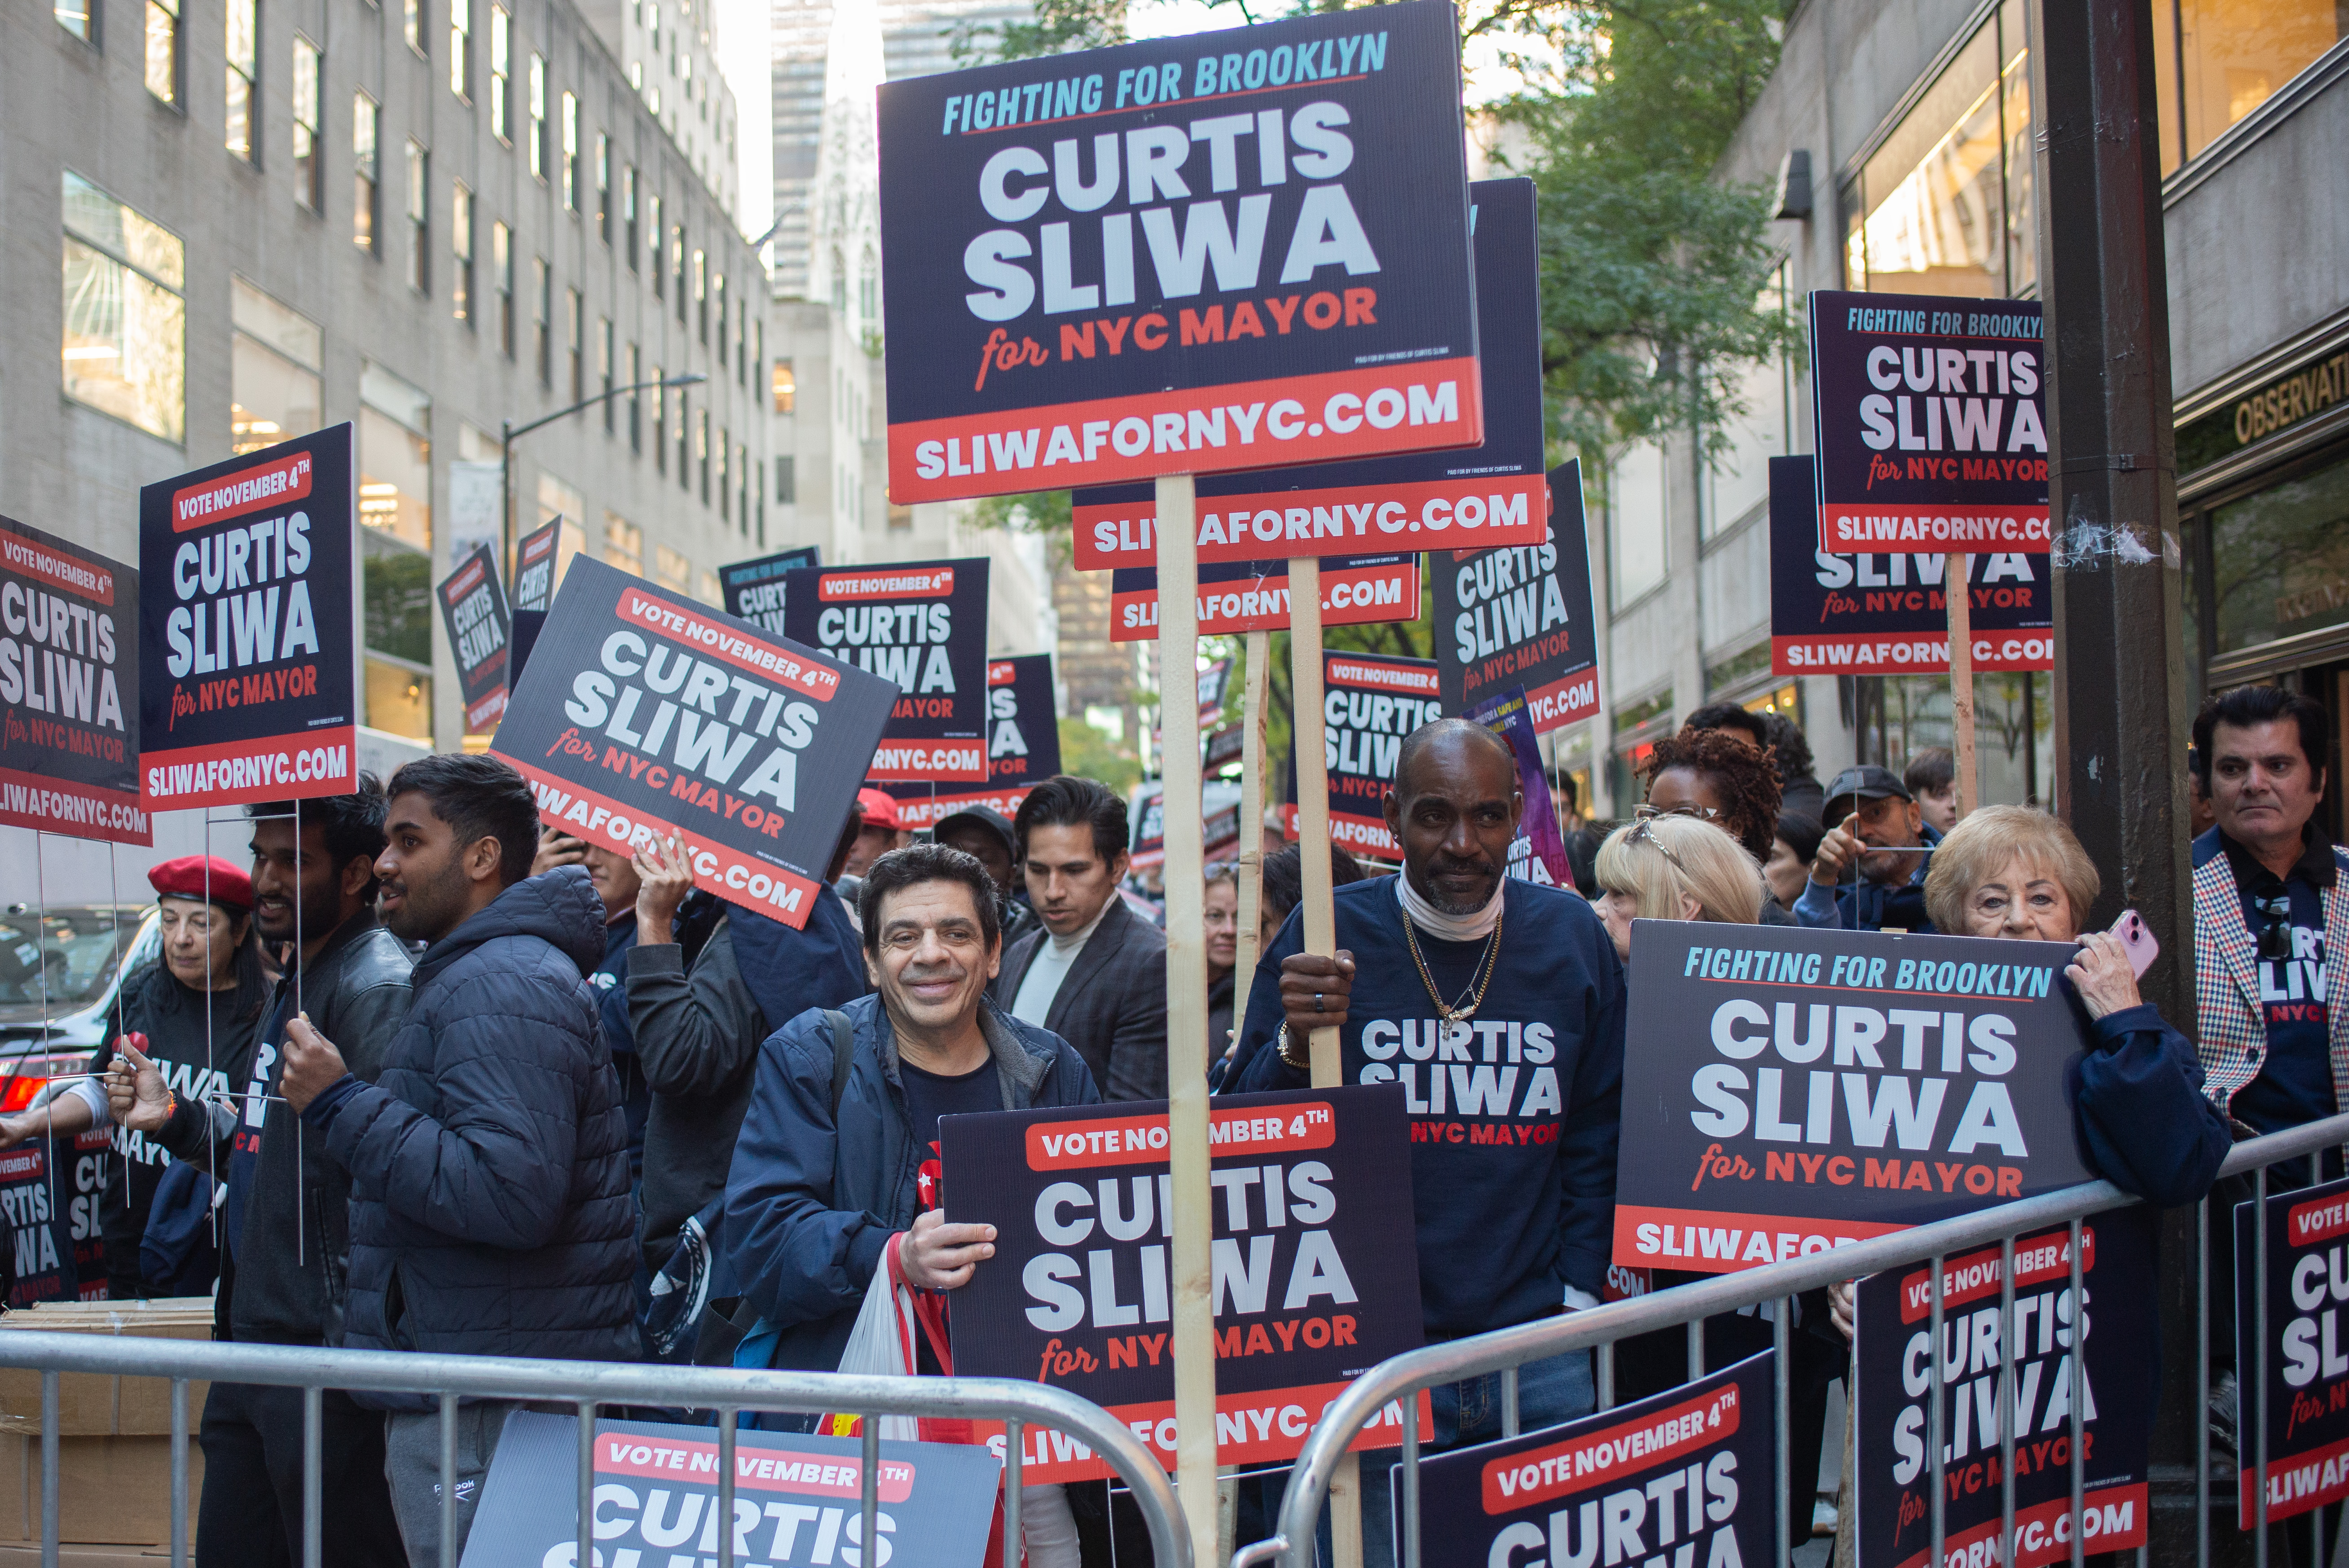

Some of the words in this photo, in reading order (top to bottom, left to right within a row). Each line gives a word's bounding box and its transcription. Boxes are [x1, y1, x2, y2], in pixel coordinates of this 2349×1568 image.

[943, 74, 1103, 136] FIGHTING
[1116, 61, 1181, 109] FOR
[1195, 31, 1388, 97] BROOKLYN
[980, 101, 1354, 222] CURTIS
[963, 184, 1381, 321] SLIWA
[975, 328, 1049, 391] for
[1060, 312, 1169, 361] NYC
[1179, 287, 1377, 347] MAYOR
[1848, 308, 1925, 334] FIGHTING
[1932, 312, 1962, 335] FOR
[1968, 314, 2044, 338] BROOKLY
[1866, 346, 2037, 395] CURTIS
[915, 381, 1459, 479] SLIWAFORNYC.COM
[1860, 394, 2047, 452] SLIWA
[180, 492, 212, 521] VOTE
[214, 466, 287, 510] NOVEMBER
[289, 459, 310, 488] 4TH
[1867, 454, 1903, 490] for
[1907, 457, 1958, 480] NYC
[1963, 459, 2048, 482] MAYOR
[1094, 493, 1528, 553] SLIAFORNYC.COM
[4, 542, 35, 568] VOTE
[36, 553, 96, 591] NOVEMBER
[97, 573, 112, 595] 4TH
[174, 511, 311, 601] CURTIS
[826, 581, 858, 594] VOTE
[860, 576, 929, 593] NOVEMBER
[932, 572, 951, 589] 4TH
[2, 581, 116, 664] CURTIS
[453, 583, 493, 635] CURTIS
[739, 581, 787, 615] CURT
[818, 603, 950, 646] CURTIS
[1455, 573, 1569, 664] SLIWA
[1821, 591, 1860, 624] for
[1866, 591, 1924, 612] NYC
[1930, 588, 2032, 610] MYOR
[167, 580, 319, 678] SLIWA
[459, 613, 505, 671] SLIWA
[631, 597, 686, 634] VOTE
[686, 622, 801, 681] NOVEMBER
[801, 666, 837, 688] 4TH
[0, 637, 124, 731] SLIWA
[601, 630, 819, 749] CURTIS
[1333, 665, 1363, 679] VOTE
[1364, 668, 1428, 688] NOVEMBER
[1463, 667, 1482, 702] for
[1485, 654, 1514, 683] NYC
[1515, 631, 1570, 673] MAYOR
[169, 684, 197, 732] for
[200, 679, 242, 712] NYC
[243, 665, 317, 705] MAYOR
[4, 709, 29, 750] for
[31, 718, 66, 750] NYC
[69, 727, 124, 763] MAYOR
[564, 670, 797, 813] SLIWA
[1325, 726, 1401, 779] SLIW
[149, 745, 347, 797] SLIWAFORNYC.COM
[545, 727, 597, 763] for
[601, 747, 669, 789] NYC
[669, 780, 785, 839] MAYOR
[1342, 777, 1377, 799] NYC
[1508, 835, 1532, 861] URTIS
[1685, 947, 1821, 984] FIGHTING
[1830, 955, 1887, 988] FOR
[1895, 959, 2053, 998] BROOKLYN
[1362, 1019, 1555, 1064] CURTIS
[1710, 998, 2017, 1076] CURTIS
[2272, 1005, 2320, 1022] NYC
[1041, 1130, 1119, 1157] VOTE
[1126, 1116, 1283, 1151] NOMBER
[1289, 1110, 1328, 1137] 4TH
[1411, 1122, 1465, 1143] NYC
[1690, 1063, 2028, 1158] SLIWA
[1691, 1142, 1755, 1192] for
[1765, 1151, 1855, 1186] NYC
[1864, 1158, 2023, 1197] MAYOR
[1034, 1160, 1336, 1247] CUTIS
[2298, 1204, 2343, 1234] VOTE
[1909, 1274, 1952, 1308] VOE
[1037, 1337, 1099, 1383] for
[1108, 1333, 1174, 1370] NY
[1214, 1314, 1357, 1358] MAYOR
[1497, 1455, 1570, 1497] VOTE
[1575, 1410, 1704, 1476] NOVEMBER
[1708, 1390, 1736, 1427] 4TH
[2287, 1392, 2326, 1440] for
[609, 1443, 687, 1470] VOTE
[876, 1466, 909, 1487] TH
[576, 1484, 897, 1568] CURTIS
[1487, 1450, 1739, 1568] CURTIS
[1894, 1490, 1926, 1548] for
